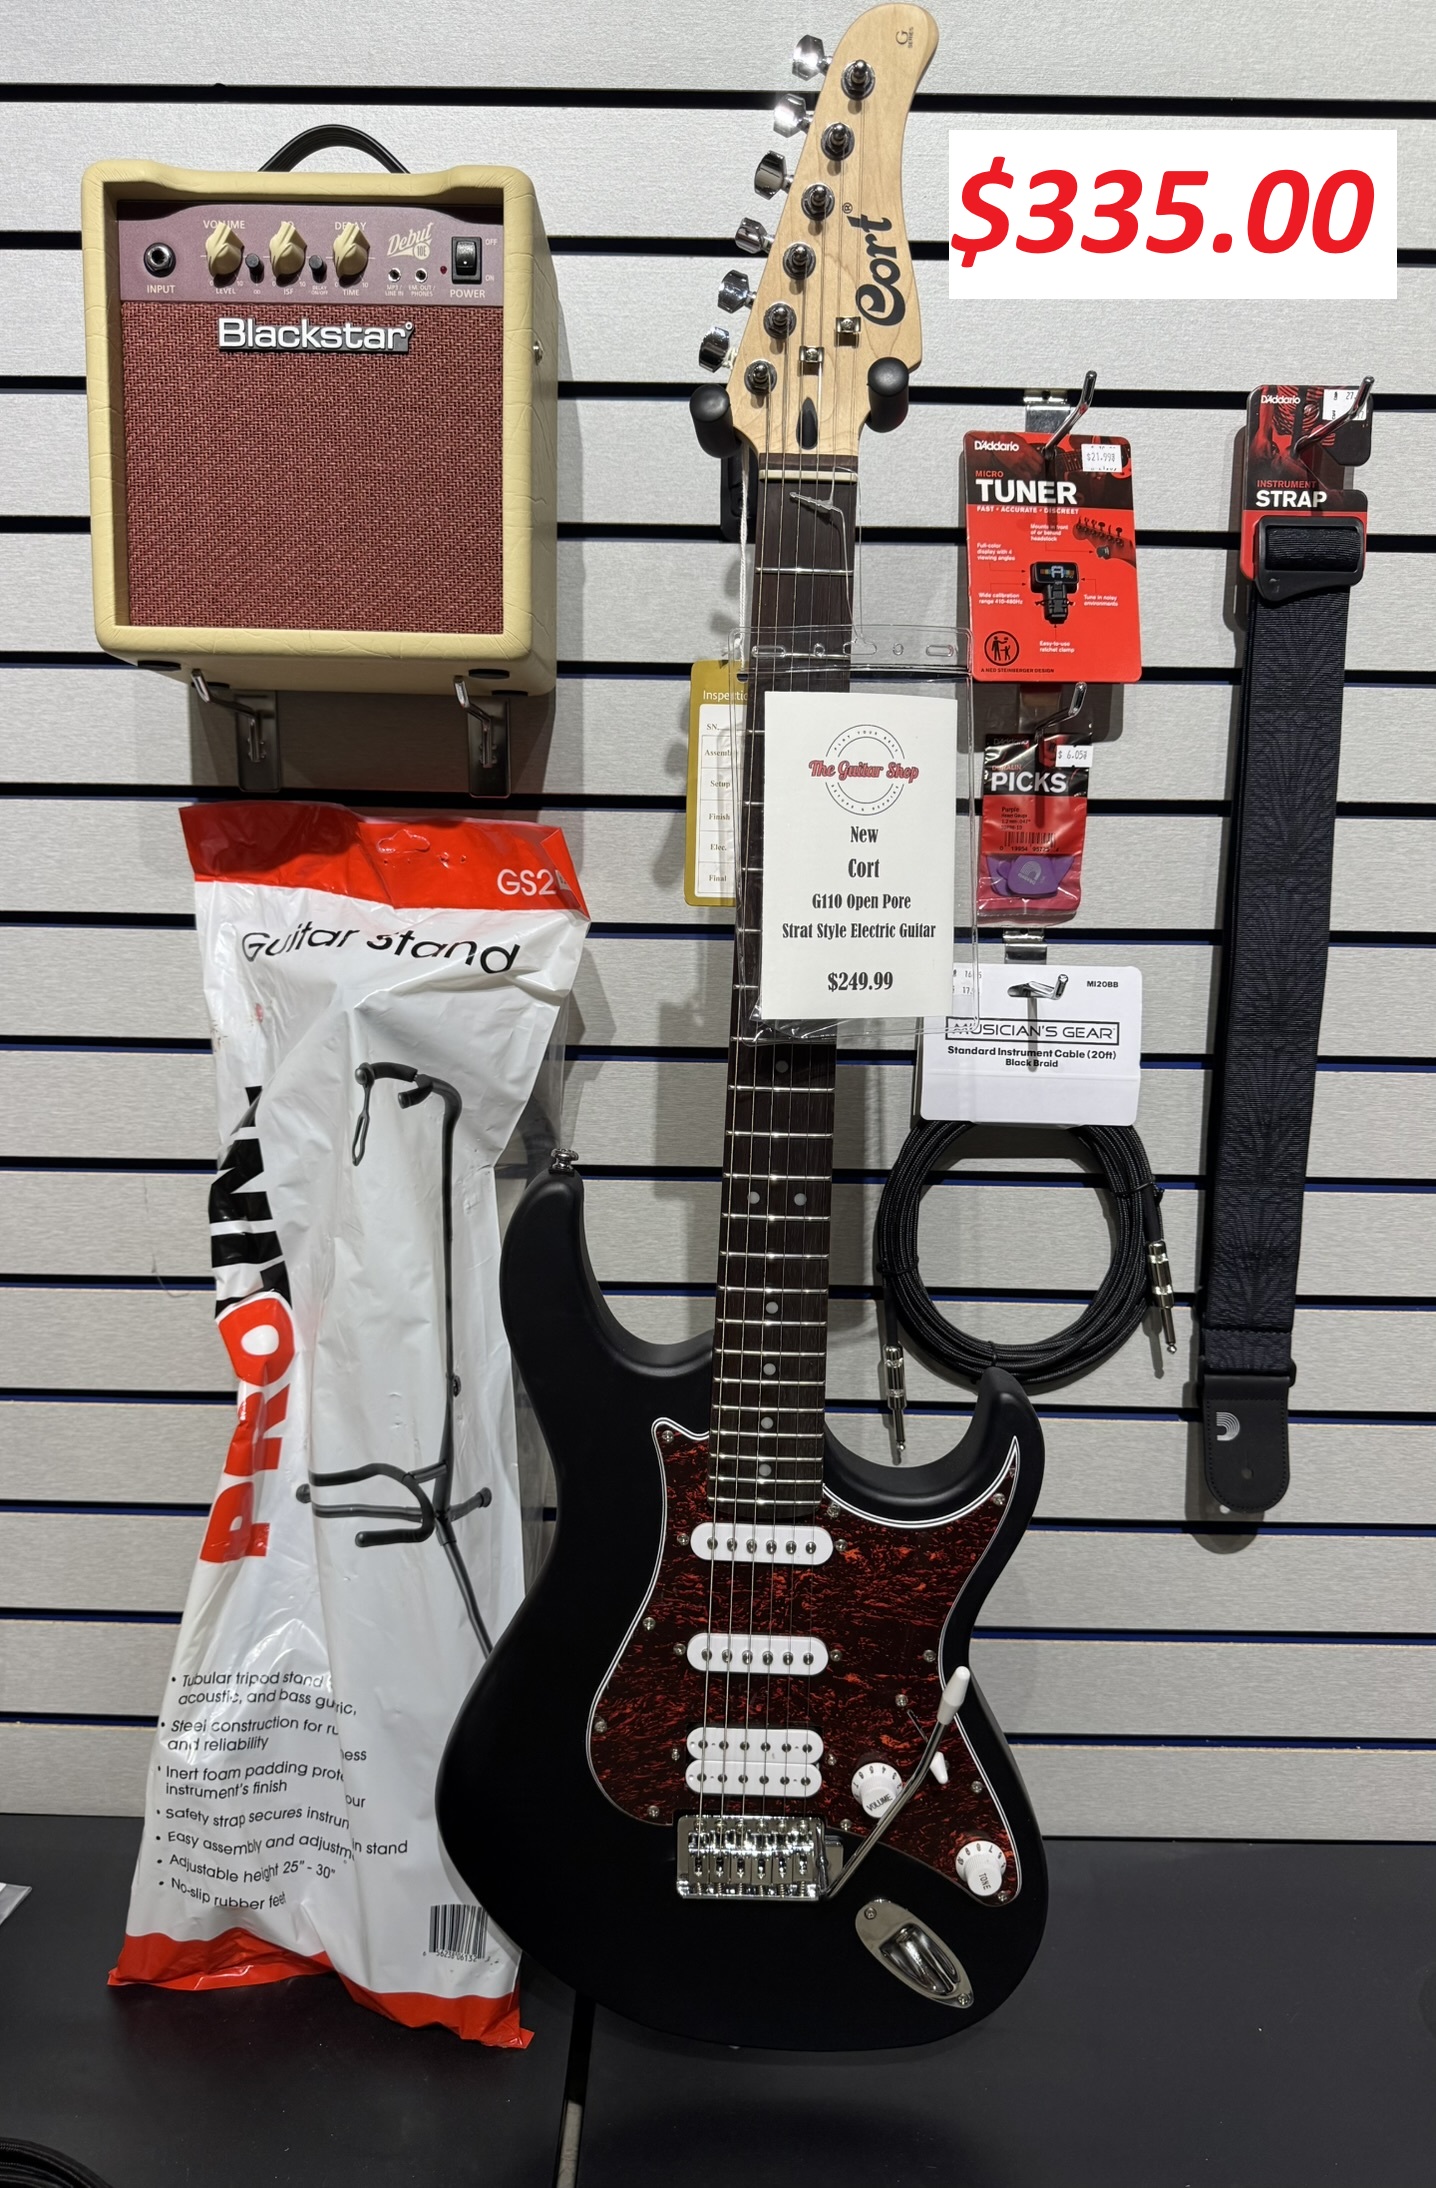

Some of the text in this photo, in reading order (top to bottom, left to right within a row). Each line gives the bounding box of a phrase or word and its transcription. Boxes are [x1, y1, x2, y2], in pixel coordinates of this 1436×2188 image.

[896, 30, 908, 45] G
[203, 220, 246, 230] VOME
[387, 222, 434, 255] Debut
[847, 214, 906, 326] Cort
[146, 284, 176, 293] INPUT
[450, 290, 485, 298] POWER
[219, 318, 407, 350] Blackstar
[1260, 395, 1300, 405] D'Addario
[974, 440, 1019, 452] D'Addario
[976, 478, 1077, 505] TUNER
[1257, 480, 1316, 488] INSTRUMENT
[1256, 490, 1327, 507] STRAP
[809, 760, 919, 784] The Guitar Shop
[710, 780, 730, 788] Setup
[991, 772, 1067, 792] PICKS
[850, 826, 878, 843] New
[848, 858, 880, 878] Cort
[812, 894, 911, 910] G110 Open Pore
[782, 922, 936, 940] Strat Style Electric Guitar
[242, 921, 520, 974] Guitar stand
[828, 972, 893, 992] $249.99
[952, 1024, 1113, 1039] MUSICIAN'S GEAR
[948, 1046, 1117, 1060] Standard Instrument Cable (20ft)
[1006, 1059, 1032, 1067] Black
[182, 1672, 232, 1688] Tubular
[236, 1672, 280, 1687] tripod
[282, 1671, 324, 1688] stand
[178, 1689, 242, 1705] acoustic,
[247, 1690, 276, 1703] and
[279, 1689, 311, 1704] bass
[211, 1717, 299, 1732] construction
[303, 1719, 322, 1732] for
[167, 1736, 269, 1751] and reliability
[166, 1766, 198, 1780] Inert
[203, 1766, 240, 1781] foam
[245, 1761, 308, 1780] padding
[166, 1779, 287, 1799] instrument's finish
[866, 1794, 893, 1811] VOLUME
[166, 1808, 209, 1825] Safety
[213, 1813, 246, 1828] strap
[249, 1807, 302, 1823] secures
[168, 1831, 199, 1849] Easy
[203, 1838, 262, 1855] assembly
[265, 1834, 295, 1849] and
[366, 1840, 408, 1855] stand
[170, 1854, 239, 1883] Adjustable
[243, 1865, 279, 1883] height
[283, 1860, 304, 1874] 25"
[316, 1863, 335, 1879] 30"
[979, 1873, 991, 1890] TONE
[171, 1878, 211, 1903] No-slip
[214, 1897, 265, 1910] rubber
